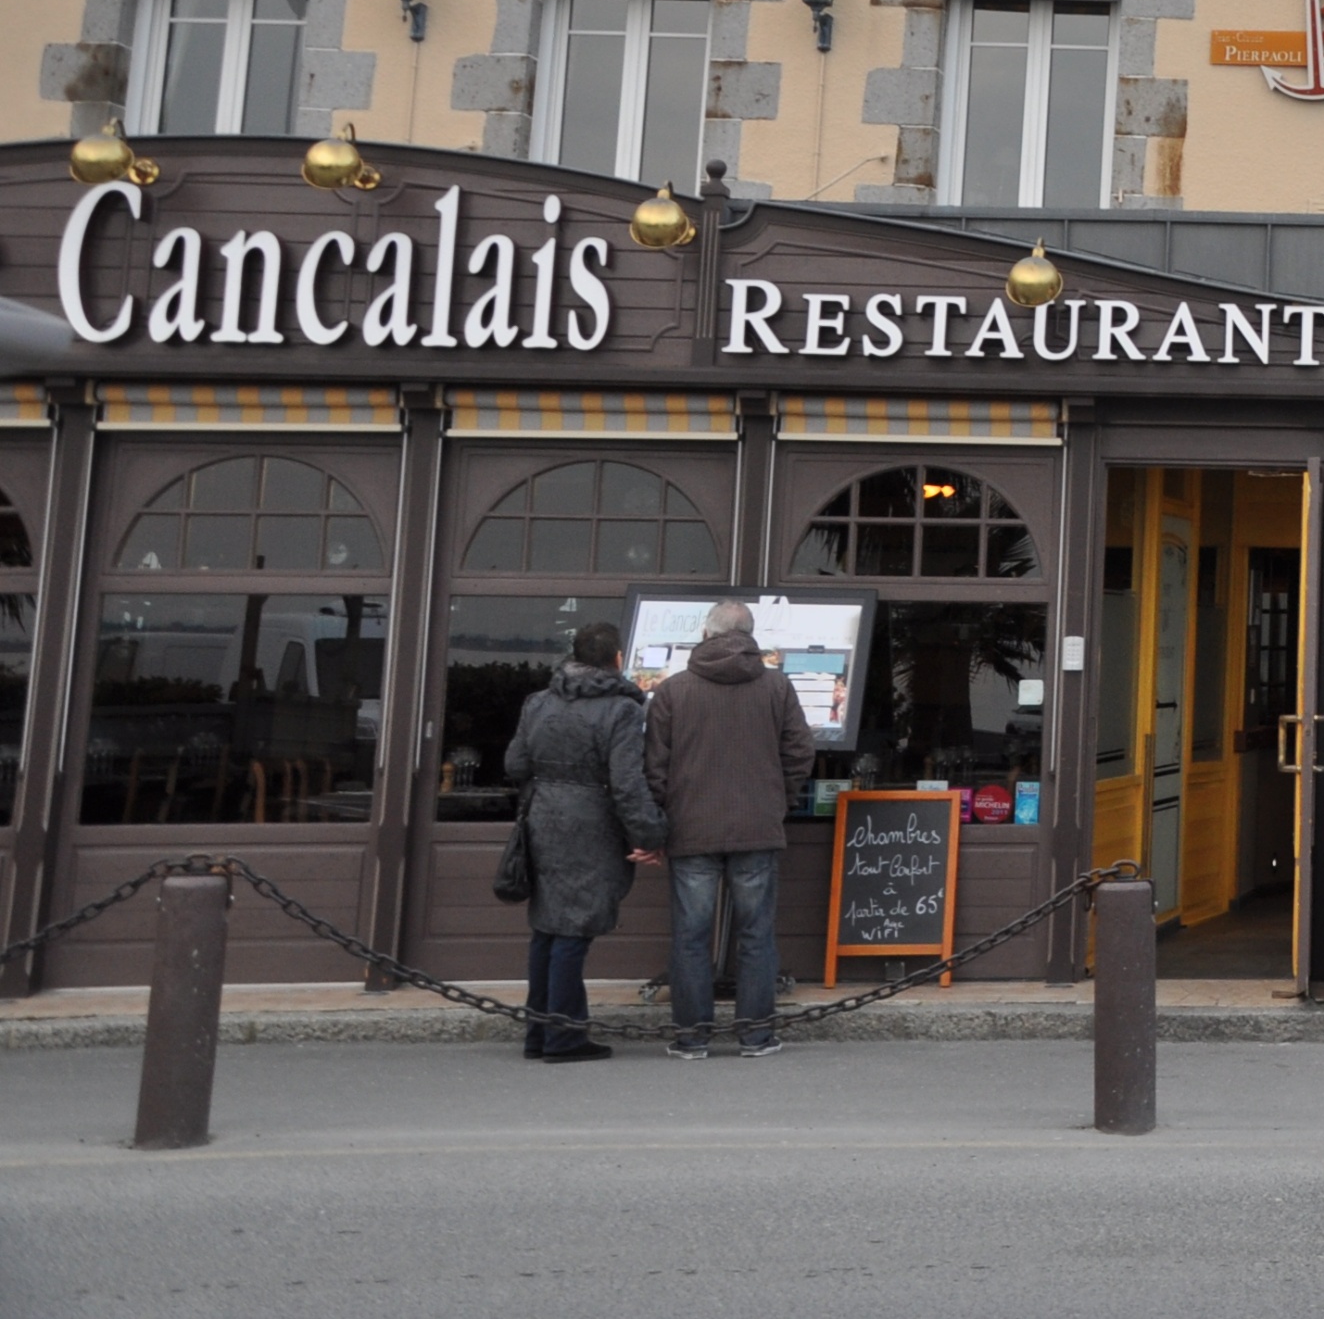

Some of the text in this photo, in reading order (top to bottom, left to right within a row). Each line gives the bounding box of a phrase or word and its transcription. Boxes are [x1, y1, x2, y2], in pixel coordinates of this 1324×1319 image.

[1225, 45, 1302, 62] PIERPAOLI
[58, 181, 612, 352] Cancalais
[643, 608, 707, 633] Le Cancala
[974, 801, 1010, 809] MICHELIN
[847, 852, 889, 876] tout
[882, 882, 898, 895] à
[844, 897, 885, 926] partir
[889, 899, 909, 916] de
